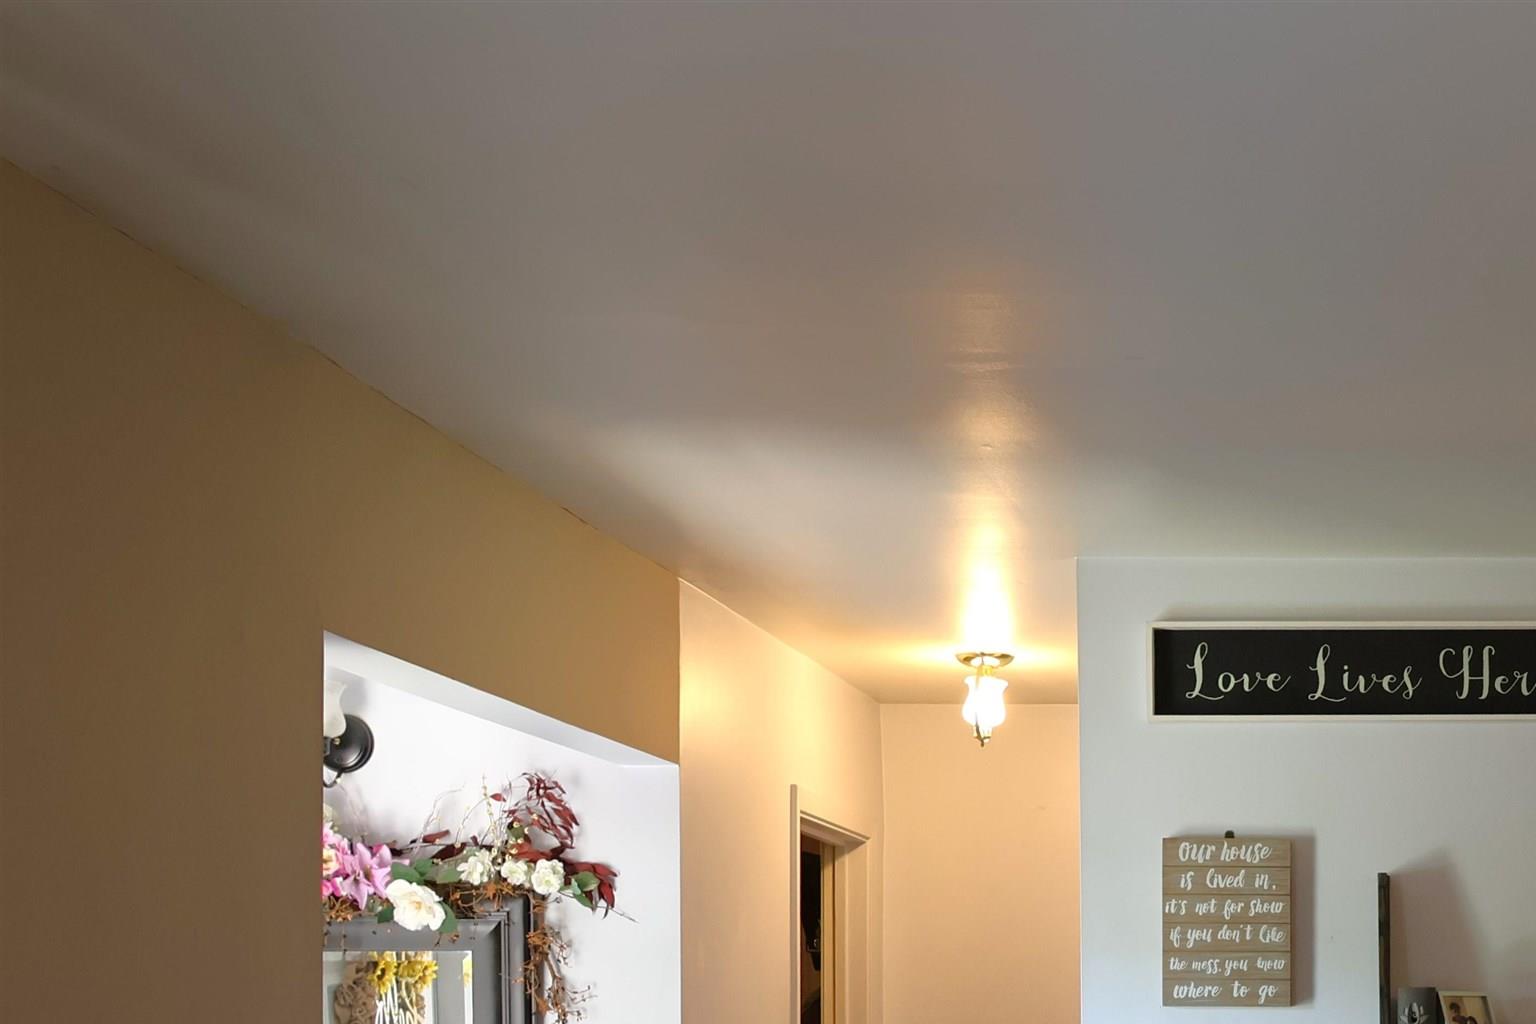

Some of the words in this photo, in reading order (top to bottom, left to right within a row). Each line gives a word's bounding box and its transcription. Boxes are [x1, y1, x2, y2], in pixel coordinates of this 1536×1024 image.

[1185, 641, 1291, 700] Love
[1307, 643, 1422, 702] Lives
[1178, 841, 1216, 863] Our
[1220, 840, 1273, 864] house
[1180, 871, 1195, 891] is
[1206, 868, 1245, 889] lived
[1165, 899, 1187, 915] it's
[1195, 898, 1217, 916] not
[1224, 899, 1245, 920] for
[1248, 898, 1286, 917] show
[1170, 926, 1183, 948] if
[1186, 930, 1212, 948] you
[1217, 924, 1253, 943] don't
[1259, 924, 1286, 944] like
[1168, 957, 1188, 970] the
[1224, 959, 1249, 976] you
[1256, 956, 1286, 970] know
[1173, 981, 1222, 999] where
[1231, 980, 1249, 998] to
[1258, 984, 1278, 1004] go
